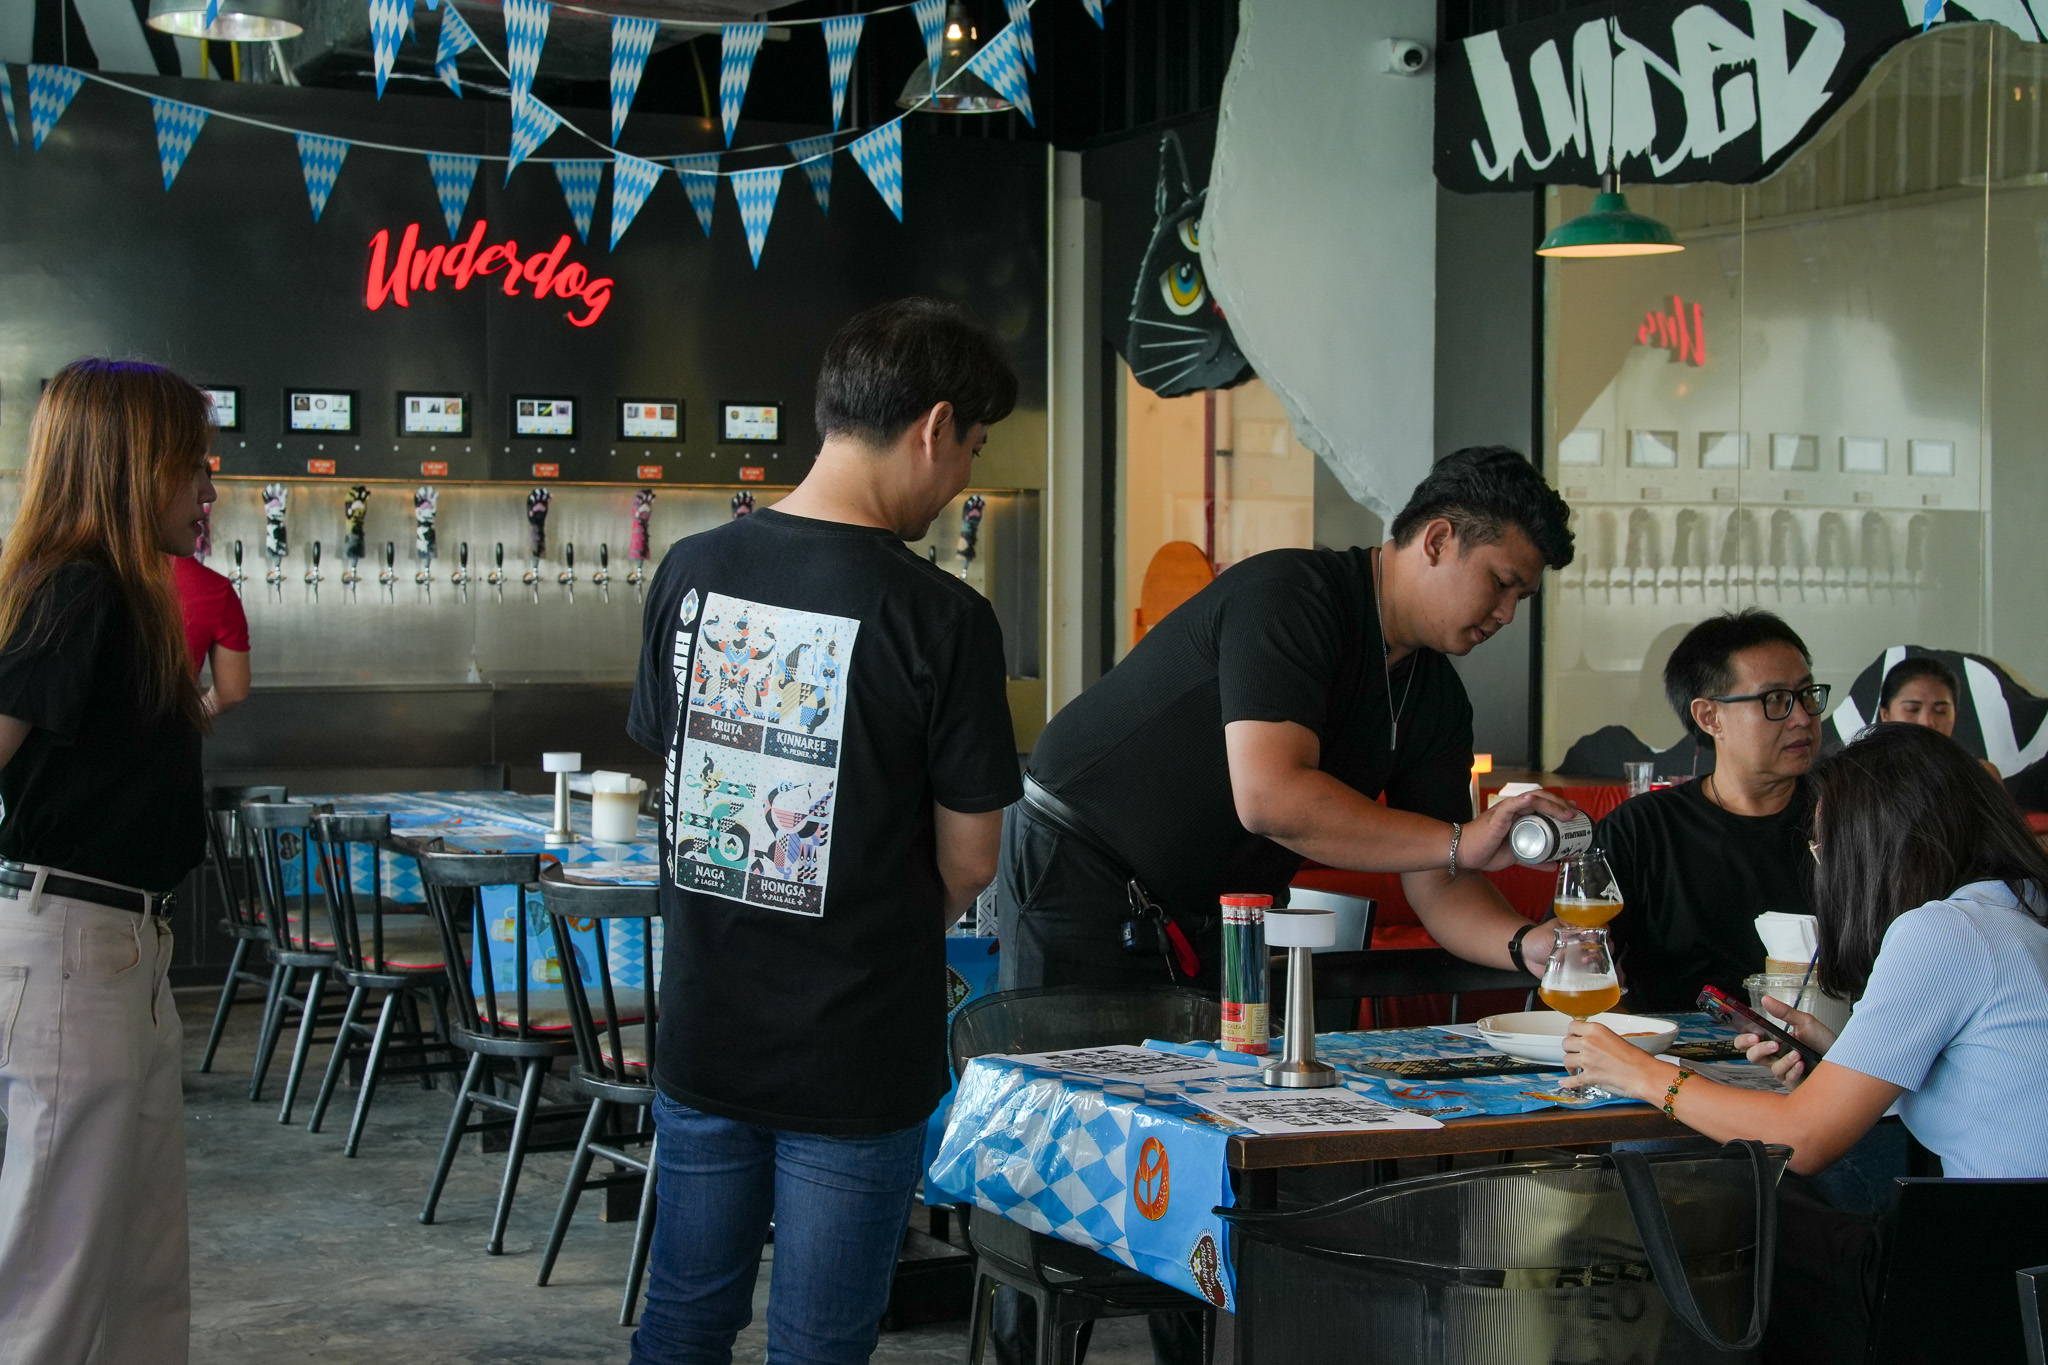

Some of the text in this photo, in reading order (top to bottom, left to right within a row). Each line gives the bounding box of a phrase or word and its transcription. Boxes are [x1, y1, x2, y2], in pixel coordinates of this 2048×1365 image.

[366, 219, 615, 328] Underdog
[711, 718, 743, 736] KRUTA
[776, 731, 827, 752] KINNAREE
[788, 748, 810, 759] PILSNER
[695, 864, 725, 881] NAGA
[700, 879, 719, 888] LAGER
[760, 879, 807, 898] HONGSA
[769, 894, 795, 905] PALE ALE
[1200, 1244, 1215, 1300] Oktoberfest
